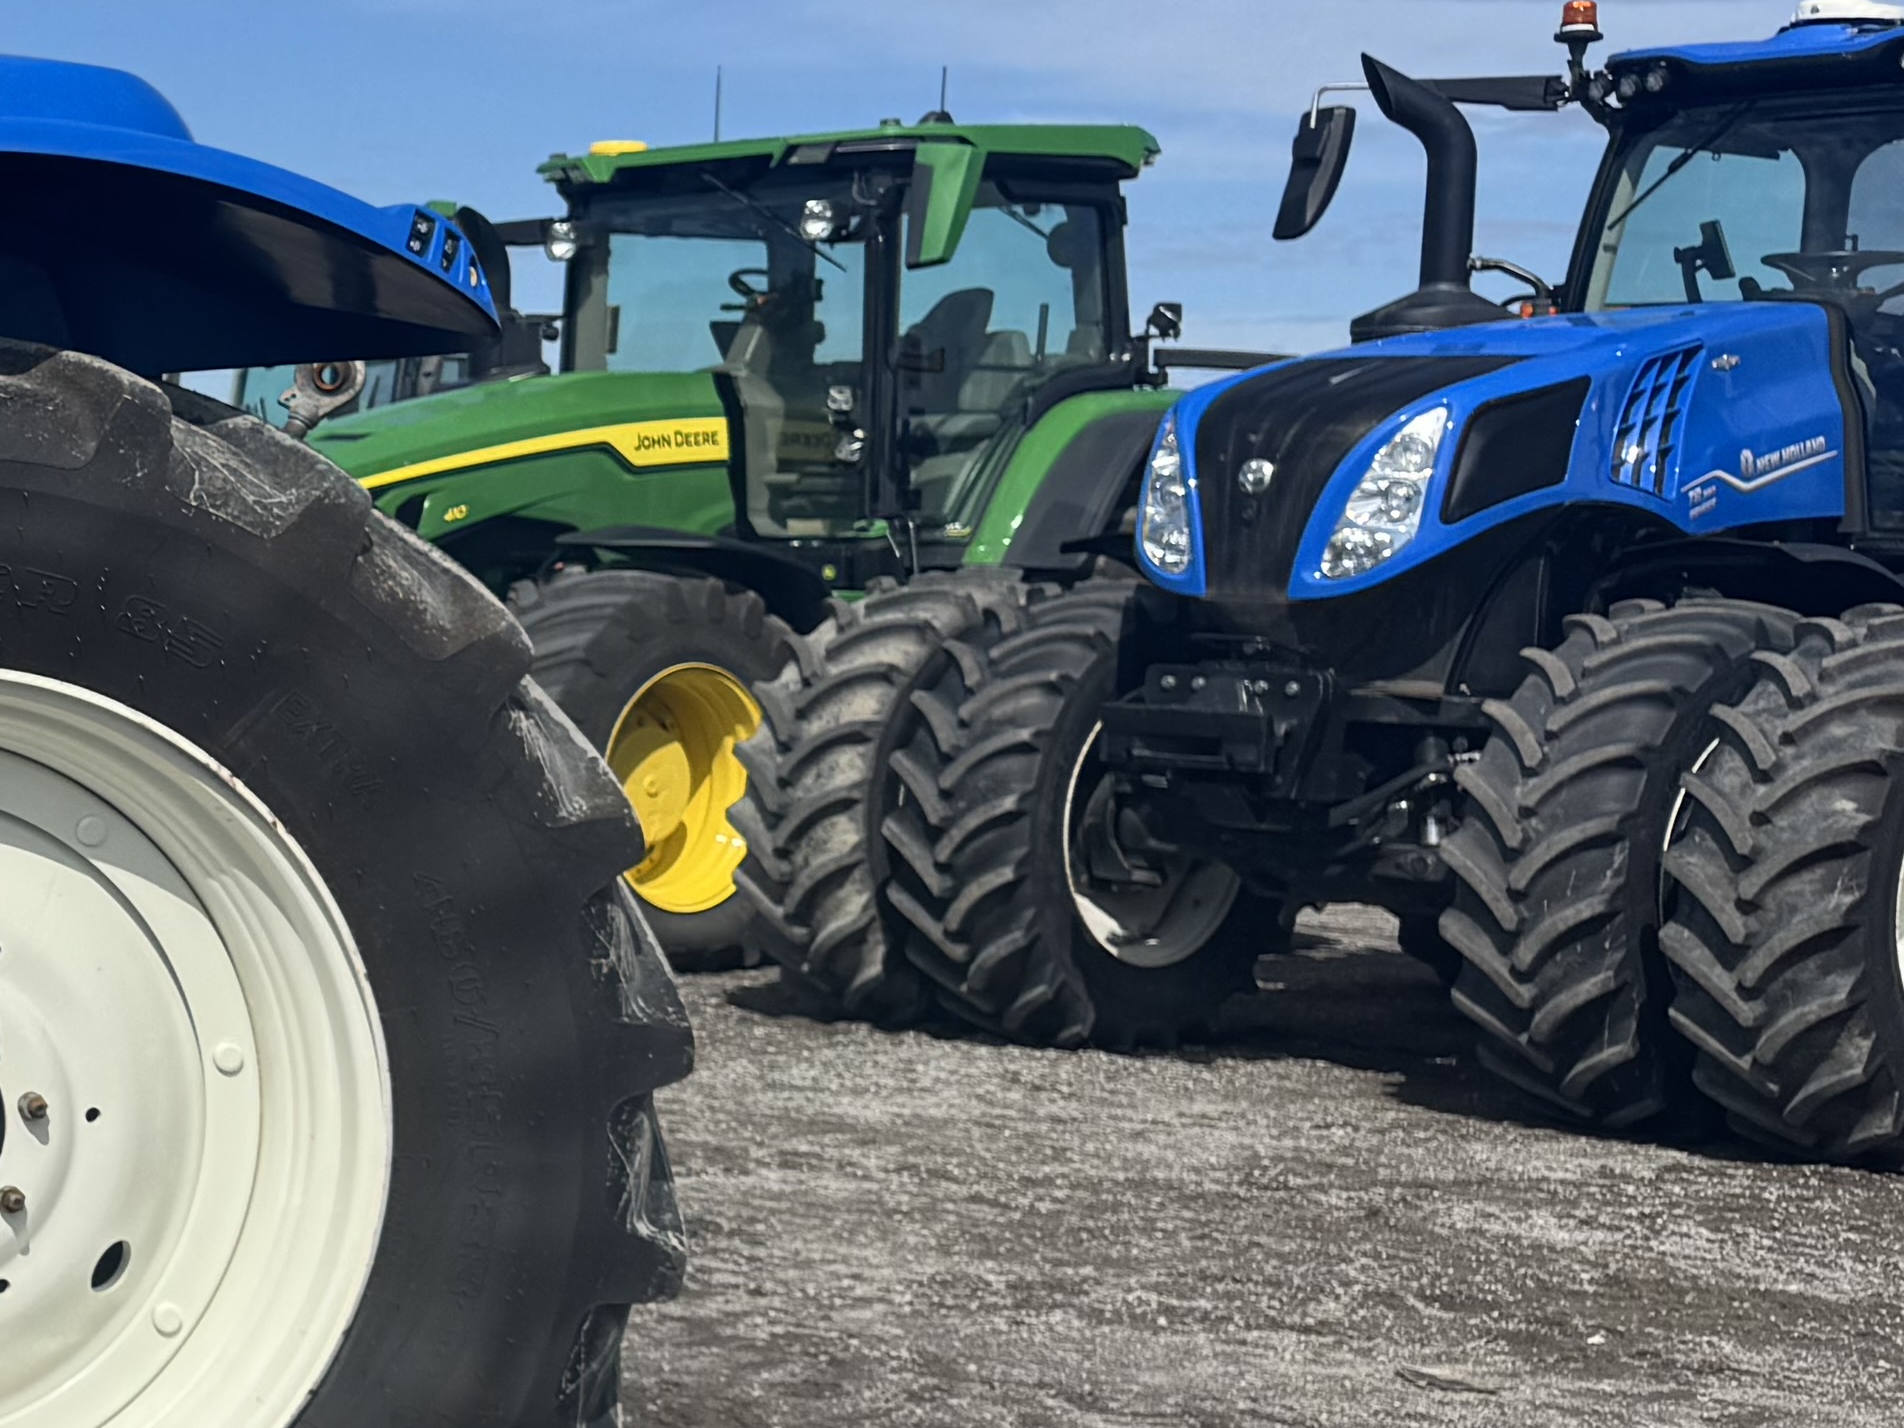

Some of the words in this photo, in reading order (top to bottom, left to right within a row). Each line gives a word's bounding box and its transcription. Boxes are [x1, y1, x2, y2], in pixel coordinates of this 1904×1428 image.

[633, 433, 672, 452] JOHN
[673, 430, 720, 449] DEERE
[1756, 450, 1781, 474] NEW
[1781, 435, 1825, 464] HOLLAND
